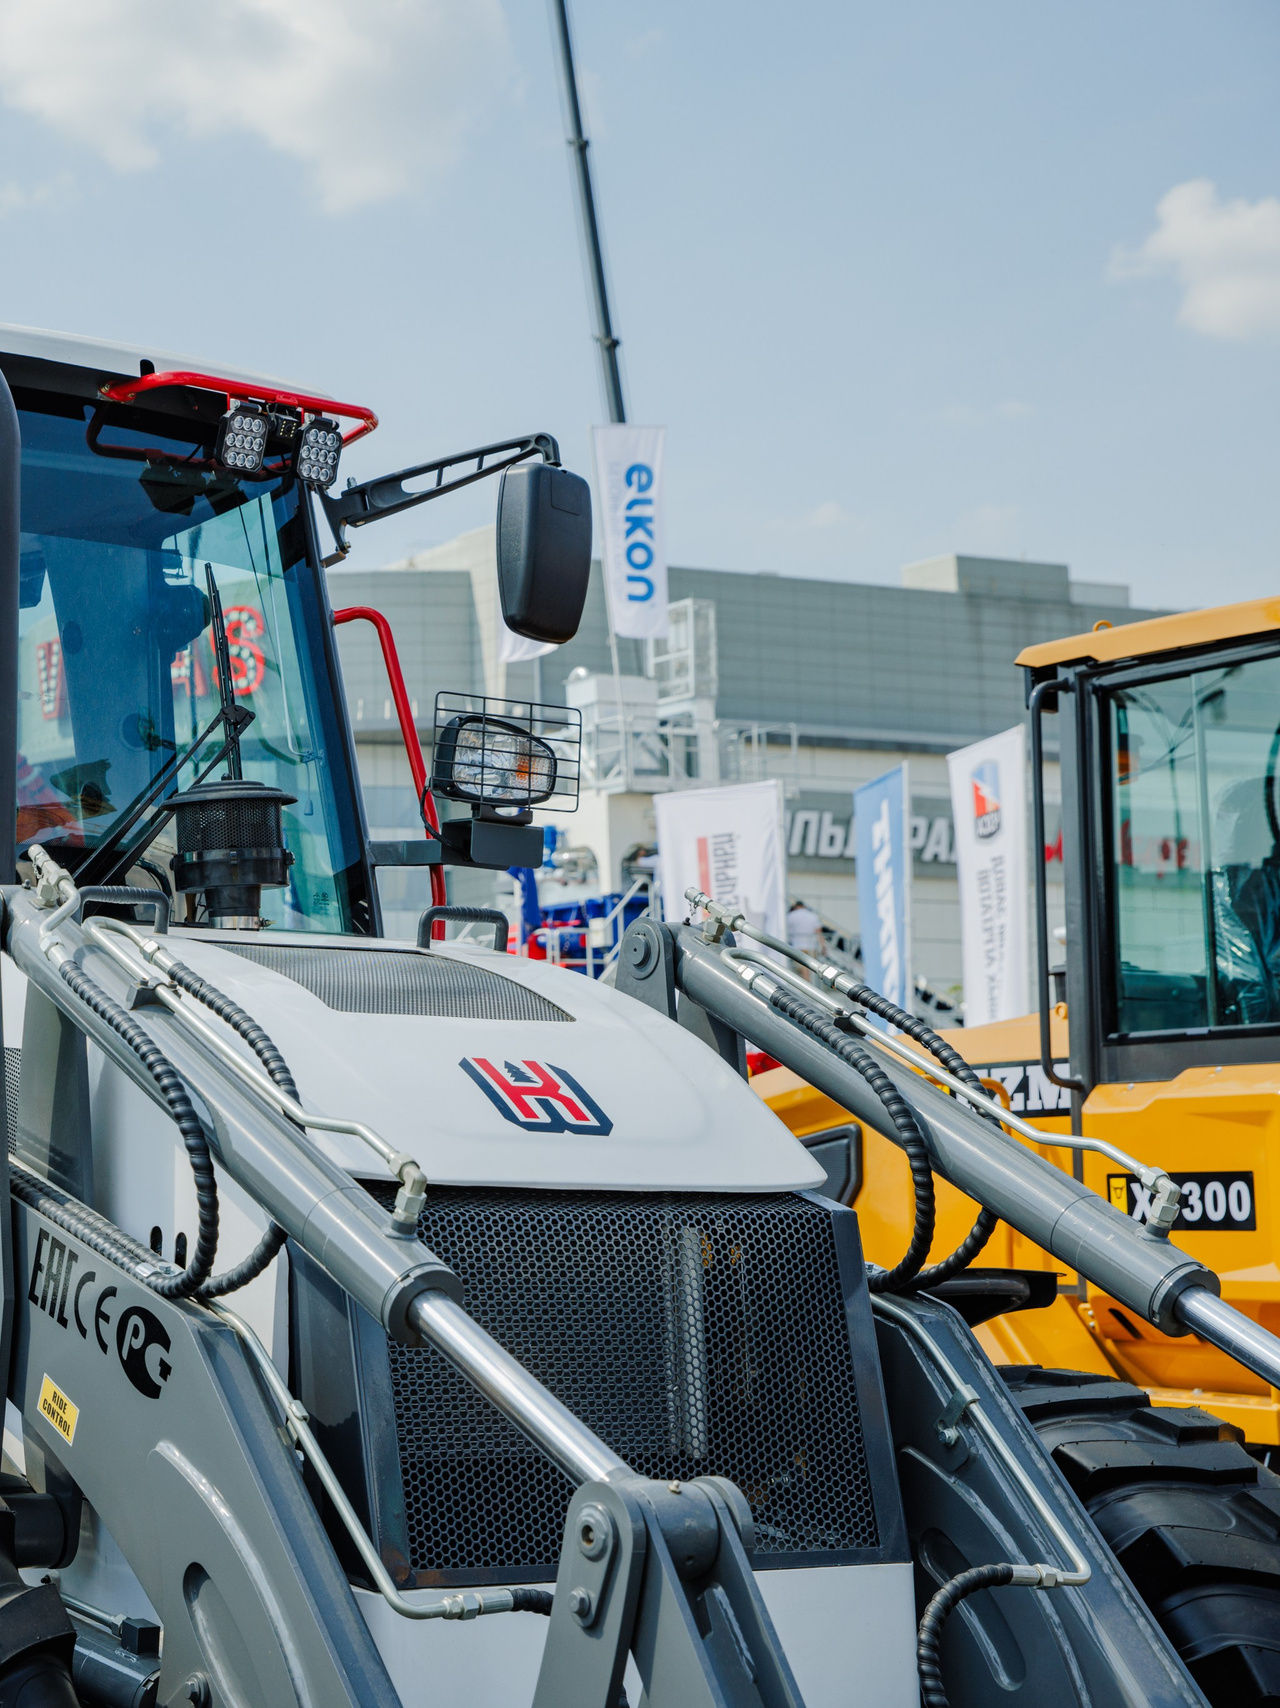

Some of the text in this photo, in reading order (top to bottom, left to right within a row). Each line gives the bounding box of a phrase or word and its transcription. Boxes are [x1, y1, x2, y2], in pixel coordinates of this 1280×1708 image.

[624, 463, 655, 602] elkon
[1129, 1180, 1252, 1223] X300
[42, 1397, 71, 1437] CONTROL
[51, 1390, 68, 1415] RIDE
